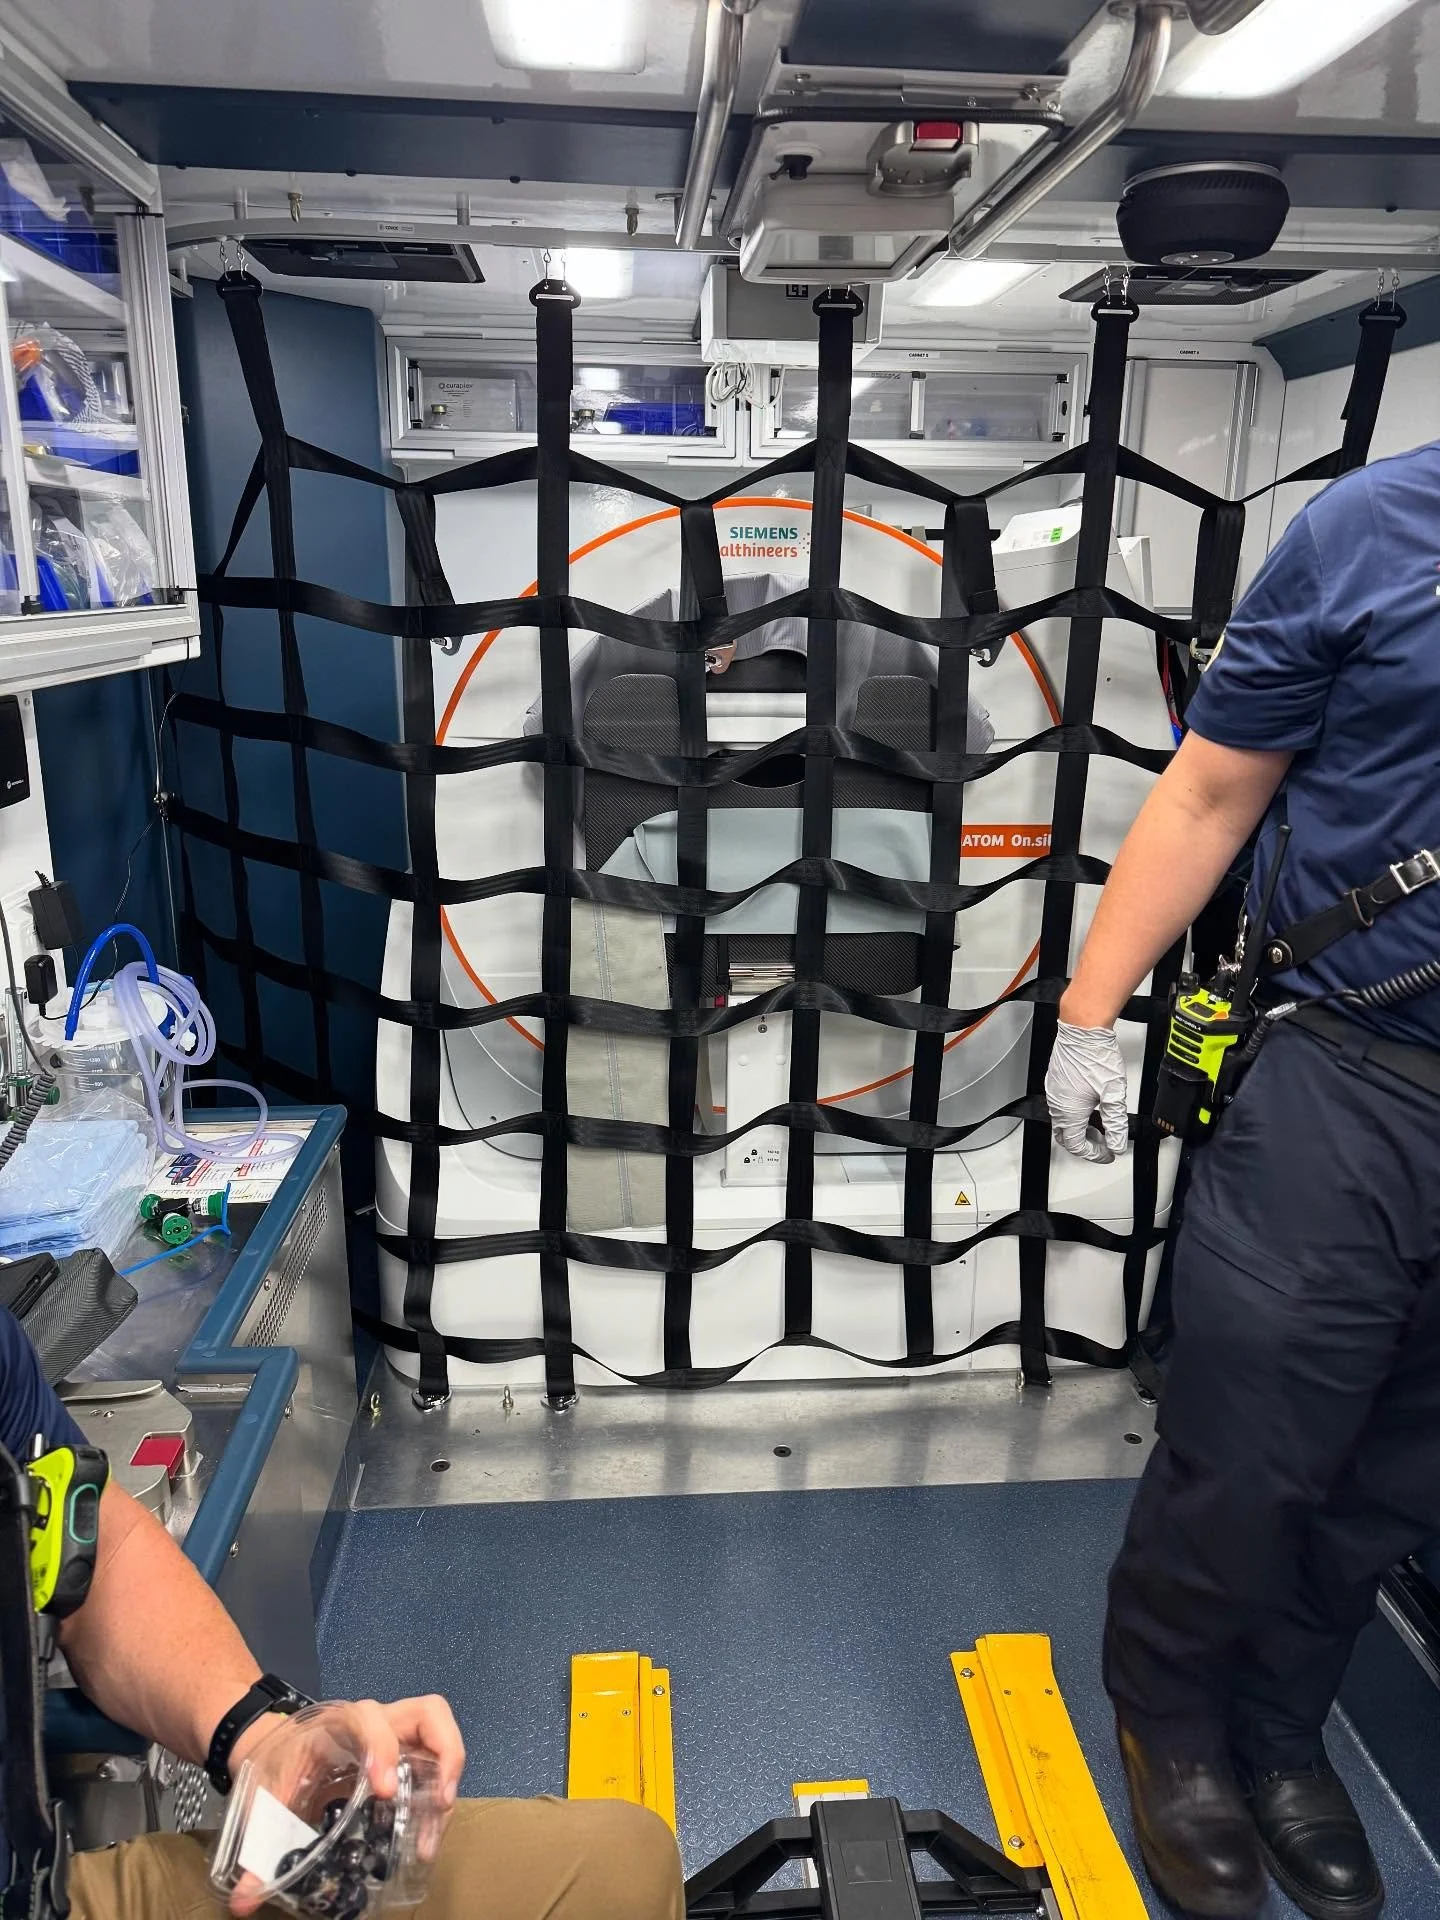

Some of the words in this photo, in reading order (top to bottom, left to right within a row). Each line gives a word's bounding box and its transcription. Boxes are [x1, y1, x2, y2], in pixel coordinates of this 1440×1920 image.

[730, 526, 798, 540] SIEMENS
[720, 543, 798, 558] althineers
[961, 834, 1004, 847] ATOM
[1175, 1015, 1202, 1031] MOTOROLA
